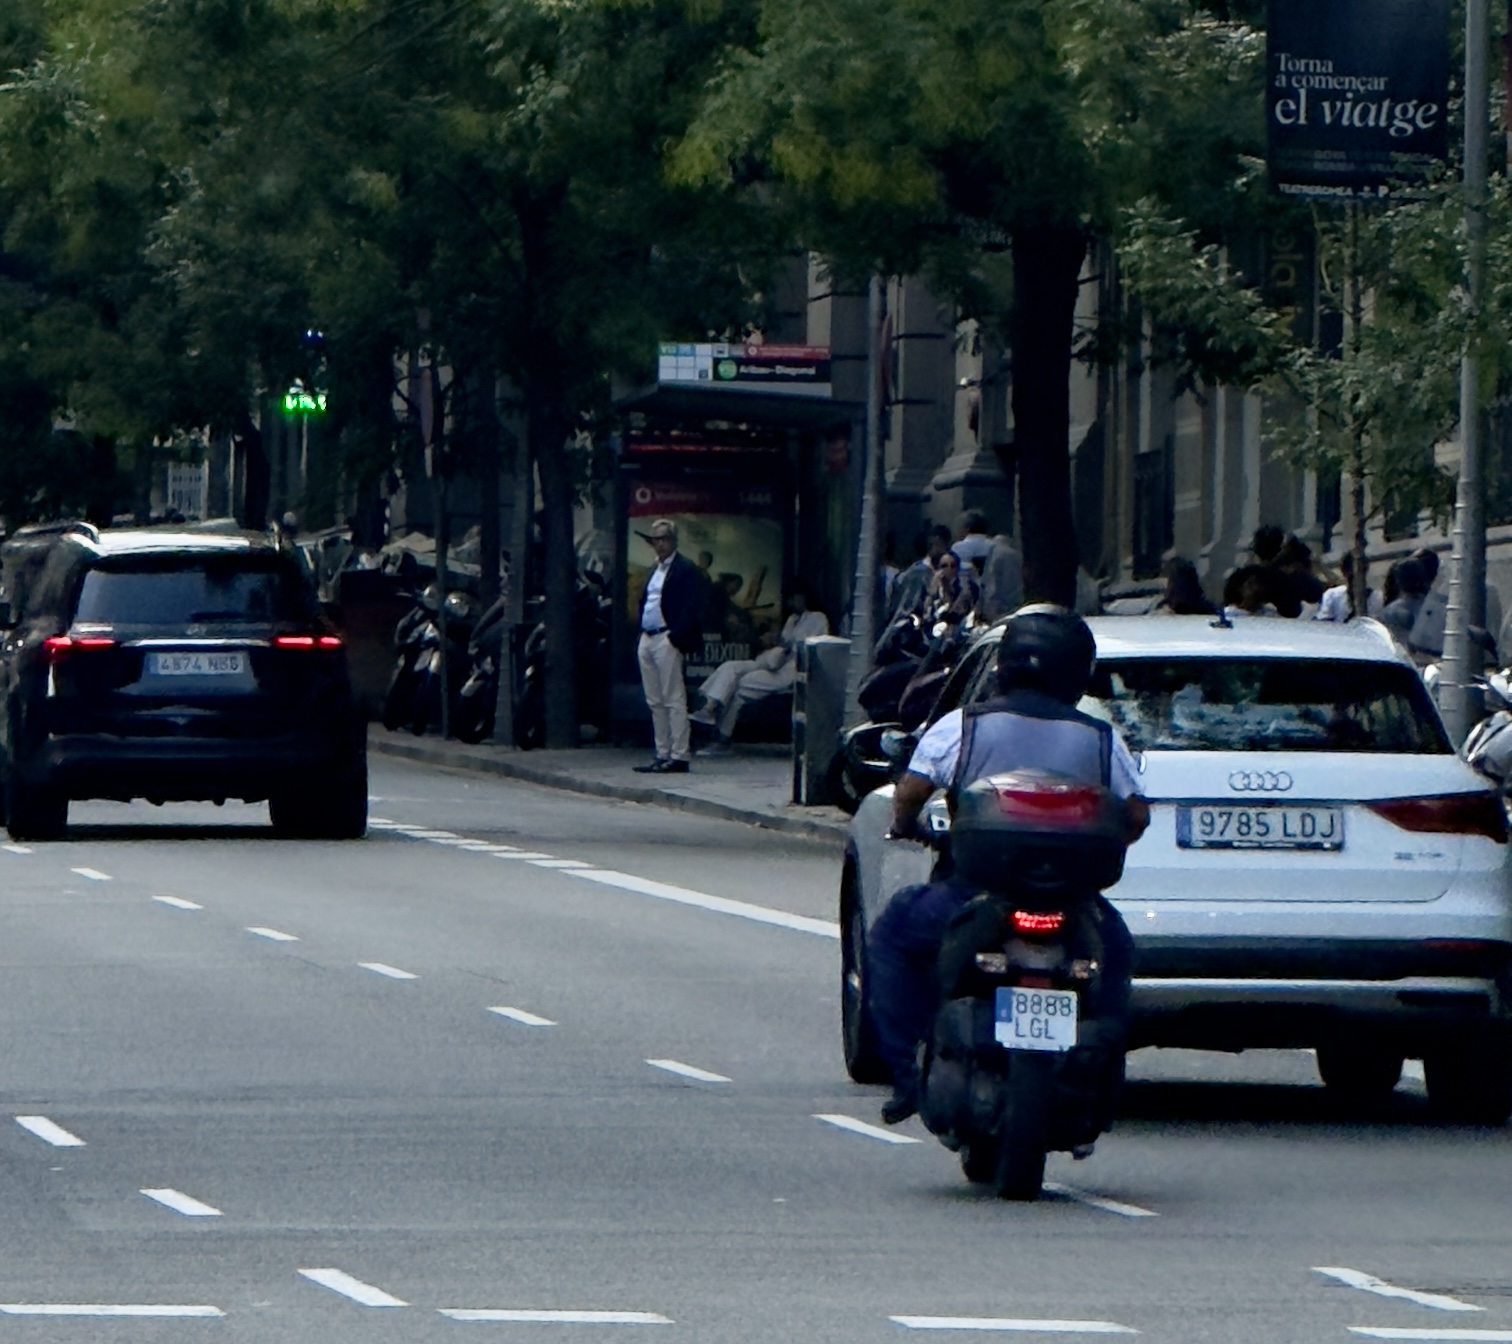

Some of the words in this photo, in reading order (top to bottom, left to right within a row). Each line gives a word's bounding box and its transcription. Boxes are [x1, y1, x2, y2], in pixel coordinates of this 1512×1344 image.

[1275, 52, 1334, 73] Torna
[1274, 76, 1287, 89] a
[1290, 74, 1389, 94] començar
[1274, 87, 1309, 125] el
[1320, 91, 1440, 138] viatge
[1199, 810, 1271, 839] 9785
[1282, 812, 1335, 839] LDJ
[1016, 993, 1072, 1017] 8888
[1014, 1017, 1056, 1040] LGL
